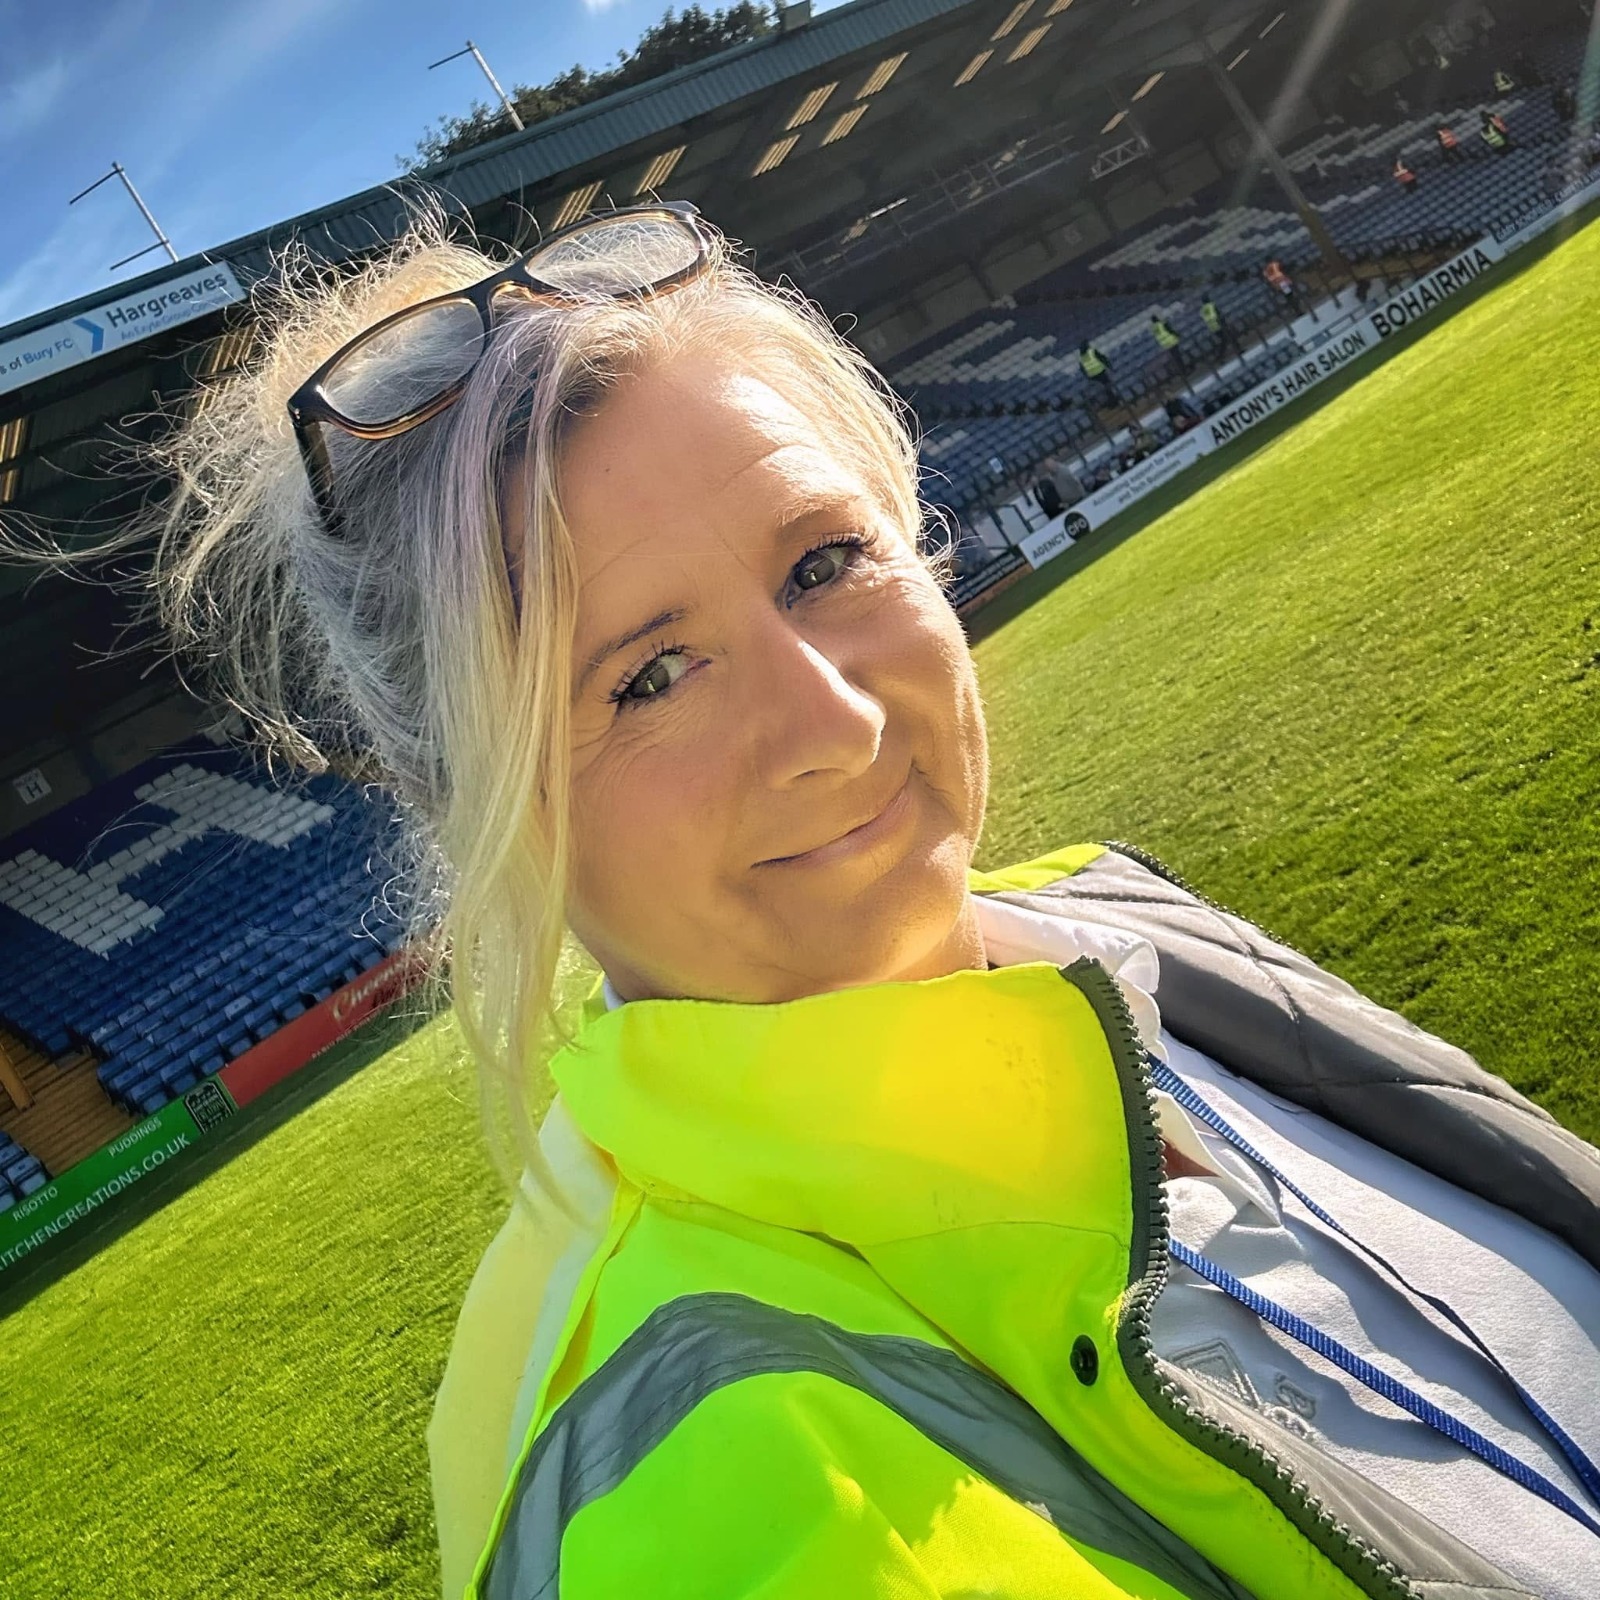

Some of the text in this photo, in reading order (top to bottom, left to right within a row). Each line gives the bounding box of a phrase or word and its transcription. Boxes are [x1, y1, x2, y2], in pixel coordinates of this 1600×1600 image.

[106, 272, 228, 328] Hargreaves
[1371, 248, 1492, 338] BOHAIRMIA
[9, 356, 23, 371] of
[23, 344, 54, 365] Bury
[54, 338, 73, 353] FC
[1210, 331, 1366, 445] ANTONY'S HAIR SALON
[1067, 517, 1088, 536] CFO
[1032, 532, 1067, 560] AGENCY
[26, 781, 43, 799] H
[108, 1116, 162, 1157] PUDDINGS
[12, 1186, 58, 1222] RISOTTO
